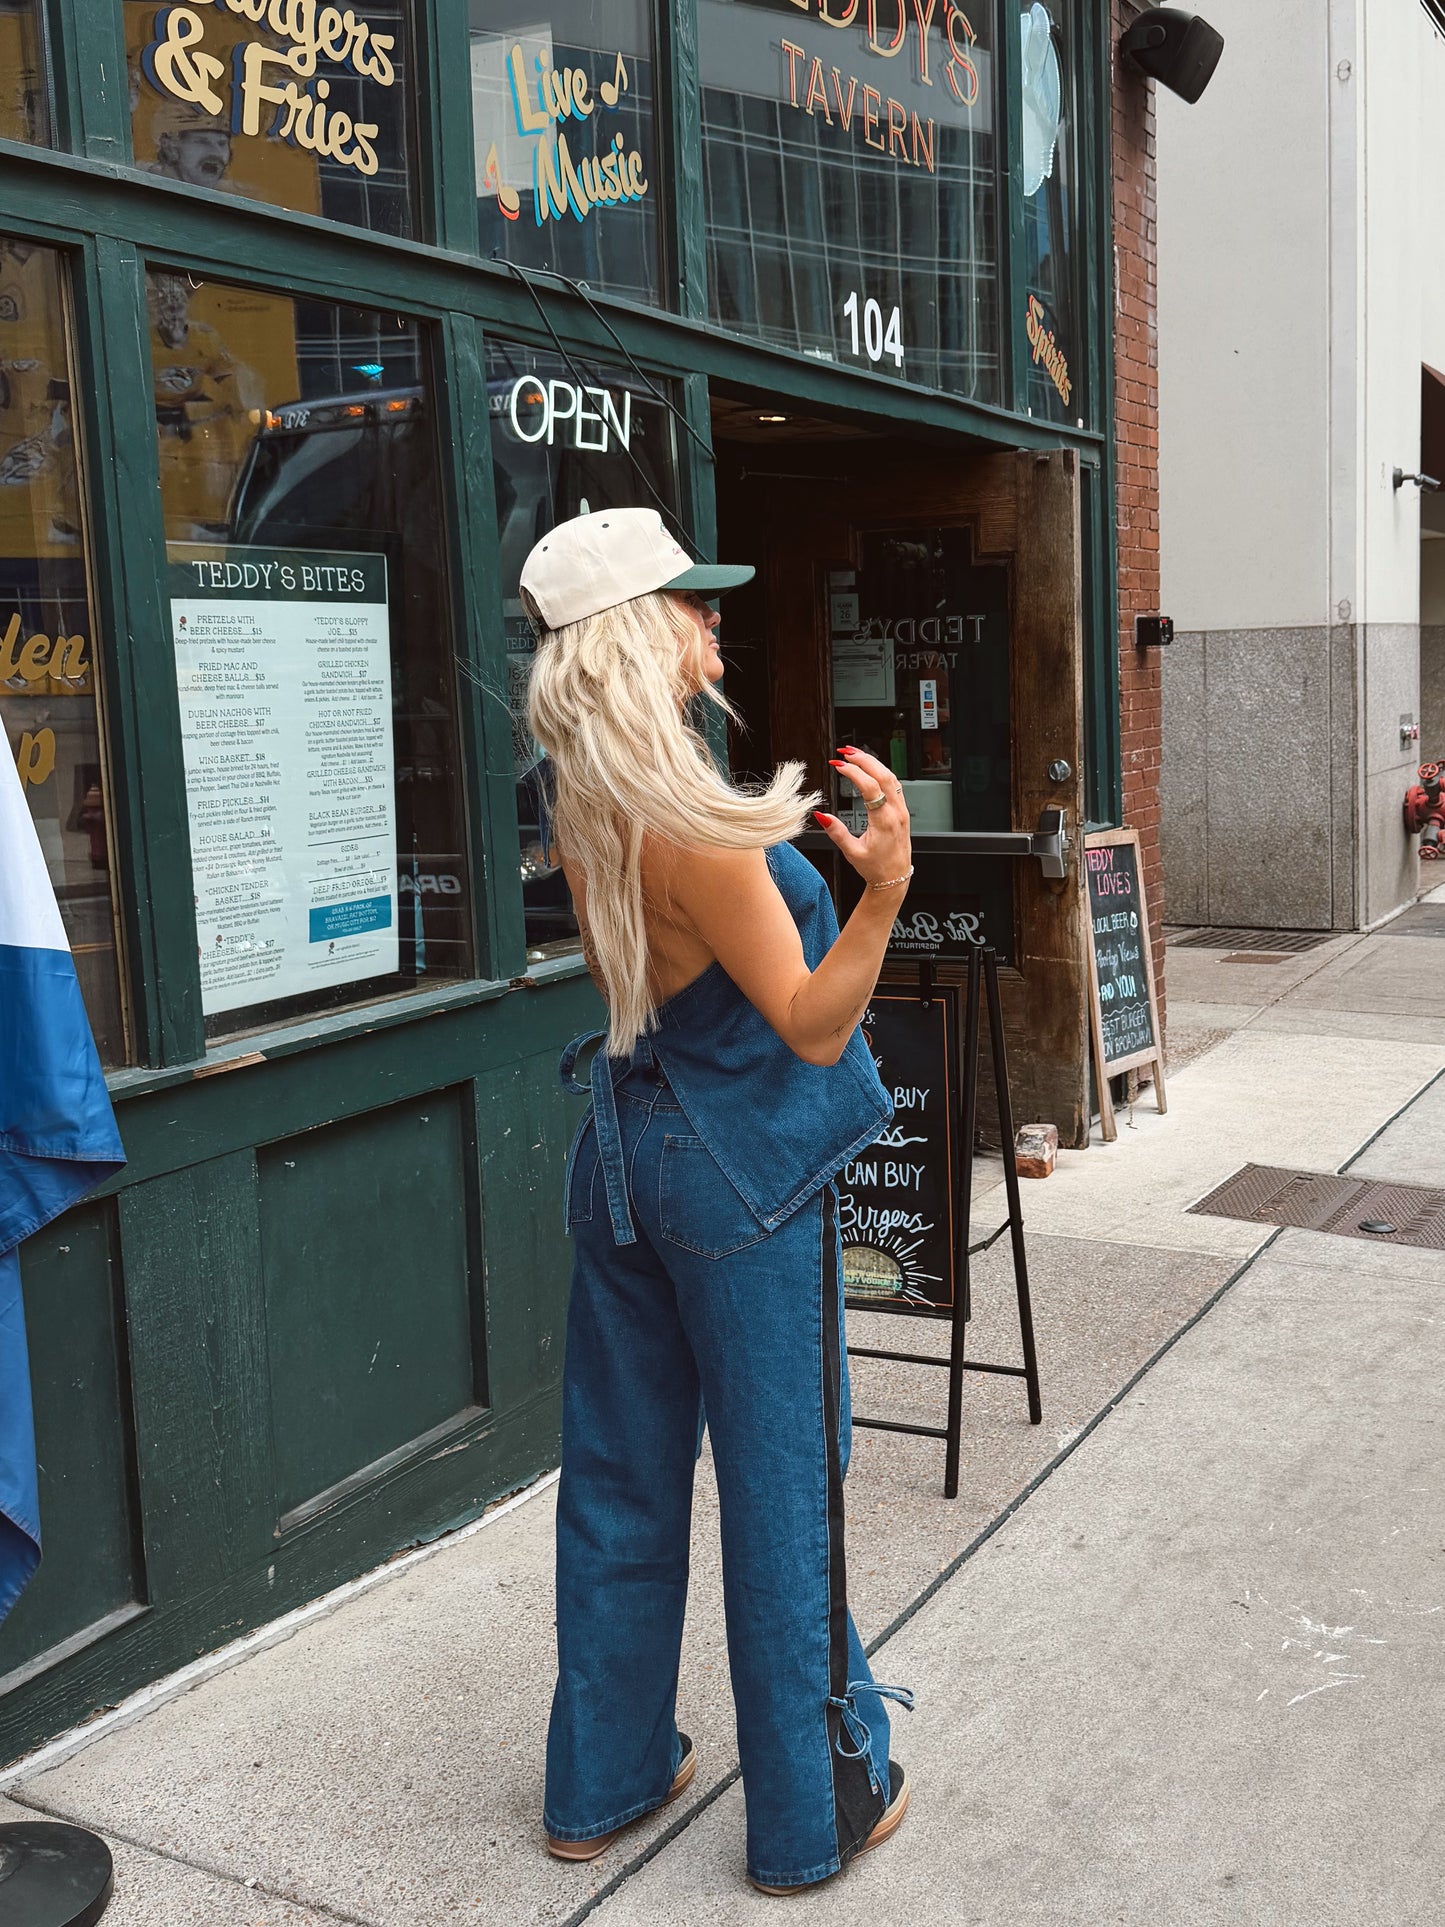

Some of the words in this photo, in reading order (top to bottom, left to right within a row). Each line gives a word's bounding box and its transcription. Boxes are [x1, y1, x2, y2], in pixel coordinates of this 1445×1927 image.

[187, 0, 395, 86] gers
[788, 0, 987, 107] DY'S
[150, 8, 225, 115] &
[239, 42, 379, 176] Fries
[508, 44, 595, 135] Live
[782, 38, 936, 174] TAVERN
[534, 132, 648, 225] Music
[844, 291, 904, 367] 104
[1026, 295, 1072, 407] Spirits
[511, 375, 631, 452] OPEN
[192, 561, 296, 590] TEDDY'S
[301, 566, 366, 592] BITES
[197, 615, 235, 624] PRETZELS
[237, 616, 255, 624] WITH
[190, 627, 210, 635] BEER
[213, 627, 242, 635] CHEESE
[328, 628, 341, 636] JOE
[199, 662, 222, 671] FRIED
[241, 662, 258, 670] AND
[318, 660, 343, 668] GRILLED
[344, 660, 369, 668] CHICKEN
[192, 674, 223, 682] CHEESE
[188, 709, 218, 719] DUBLIN
[220, 708, 252, 717] NACHOS
[254, 707, 271, 716] WITH
[318, 710, 331, 718] HOT
[356, 708, 372, 716] FRIED
[196, 721, 217, 729] BEER
[218, 719, 248, 728] CHEESE
[309, 720, 335, 728] CHICKEN
[337, 719, 366, 727] SANDWICH
[199, 756, 219, 765] WING
[220, 754, 250, 763] BASKET
[307, 769, 332, 778] GRILLED
[333, 767, 356, 776] CHEESE
[358, 765, 386, 774] SANDWICH
[323, 779, 337, 787] WITH
[338, 777, 358, 786] BACON
[198, 800, 221, 810] FRIED
[222, 797, 254, 807] PICKLES
[309, 811, 330, 821] BLACK
[332, 809, 349, 818] BEAN
[199, 834, 227, 845] HOUSE
[229, 831, 255, 842] SALAD
[1085, 849, 1114, 871] TEDDY
[241, 880, 269, 891] TENDER
[313, 885, 330, 894] DEEP
[1097, 872, 1131, 896] LOVES
[215, 895, 243, 906] BASKET
[1111, 911, 1129, 930] BEER
[1115, 975, 1137, 998] YOU!
[1121, 1008, 1147, 1031] BURGER
[894, 1086, 930, 1111] BUY
[845, 1161, 878, 1187] CAN
[884, 1161, 926, 1191] BUY
[839, 1193, 935, 1238] Burgers
